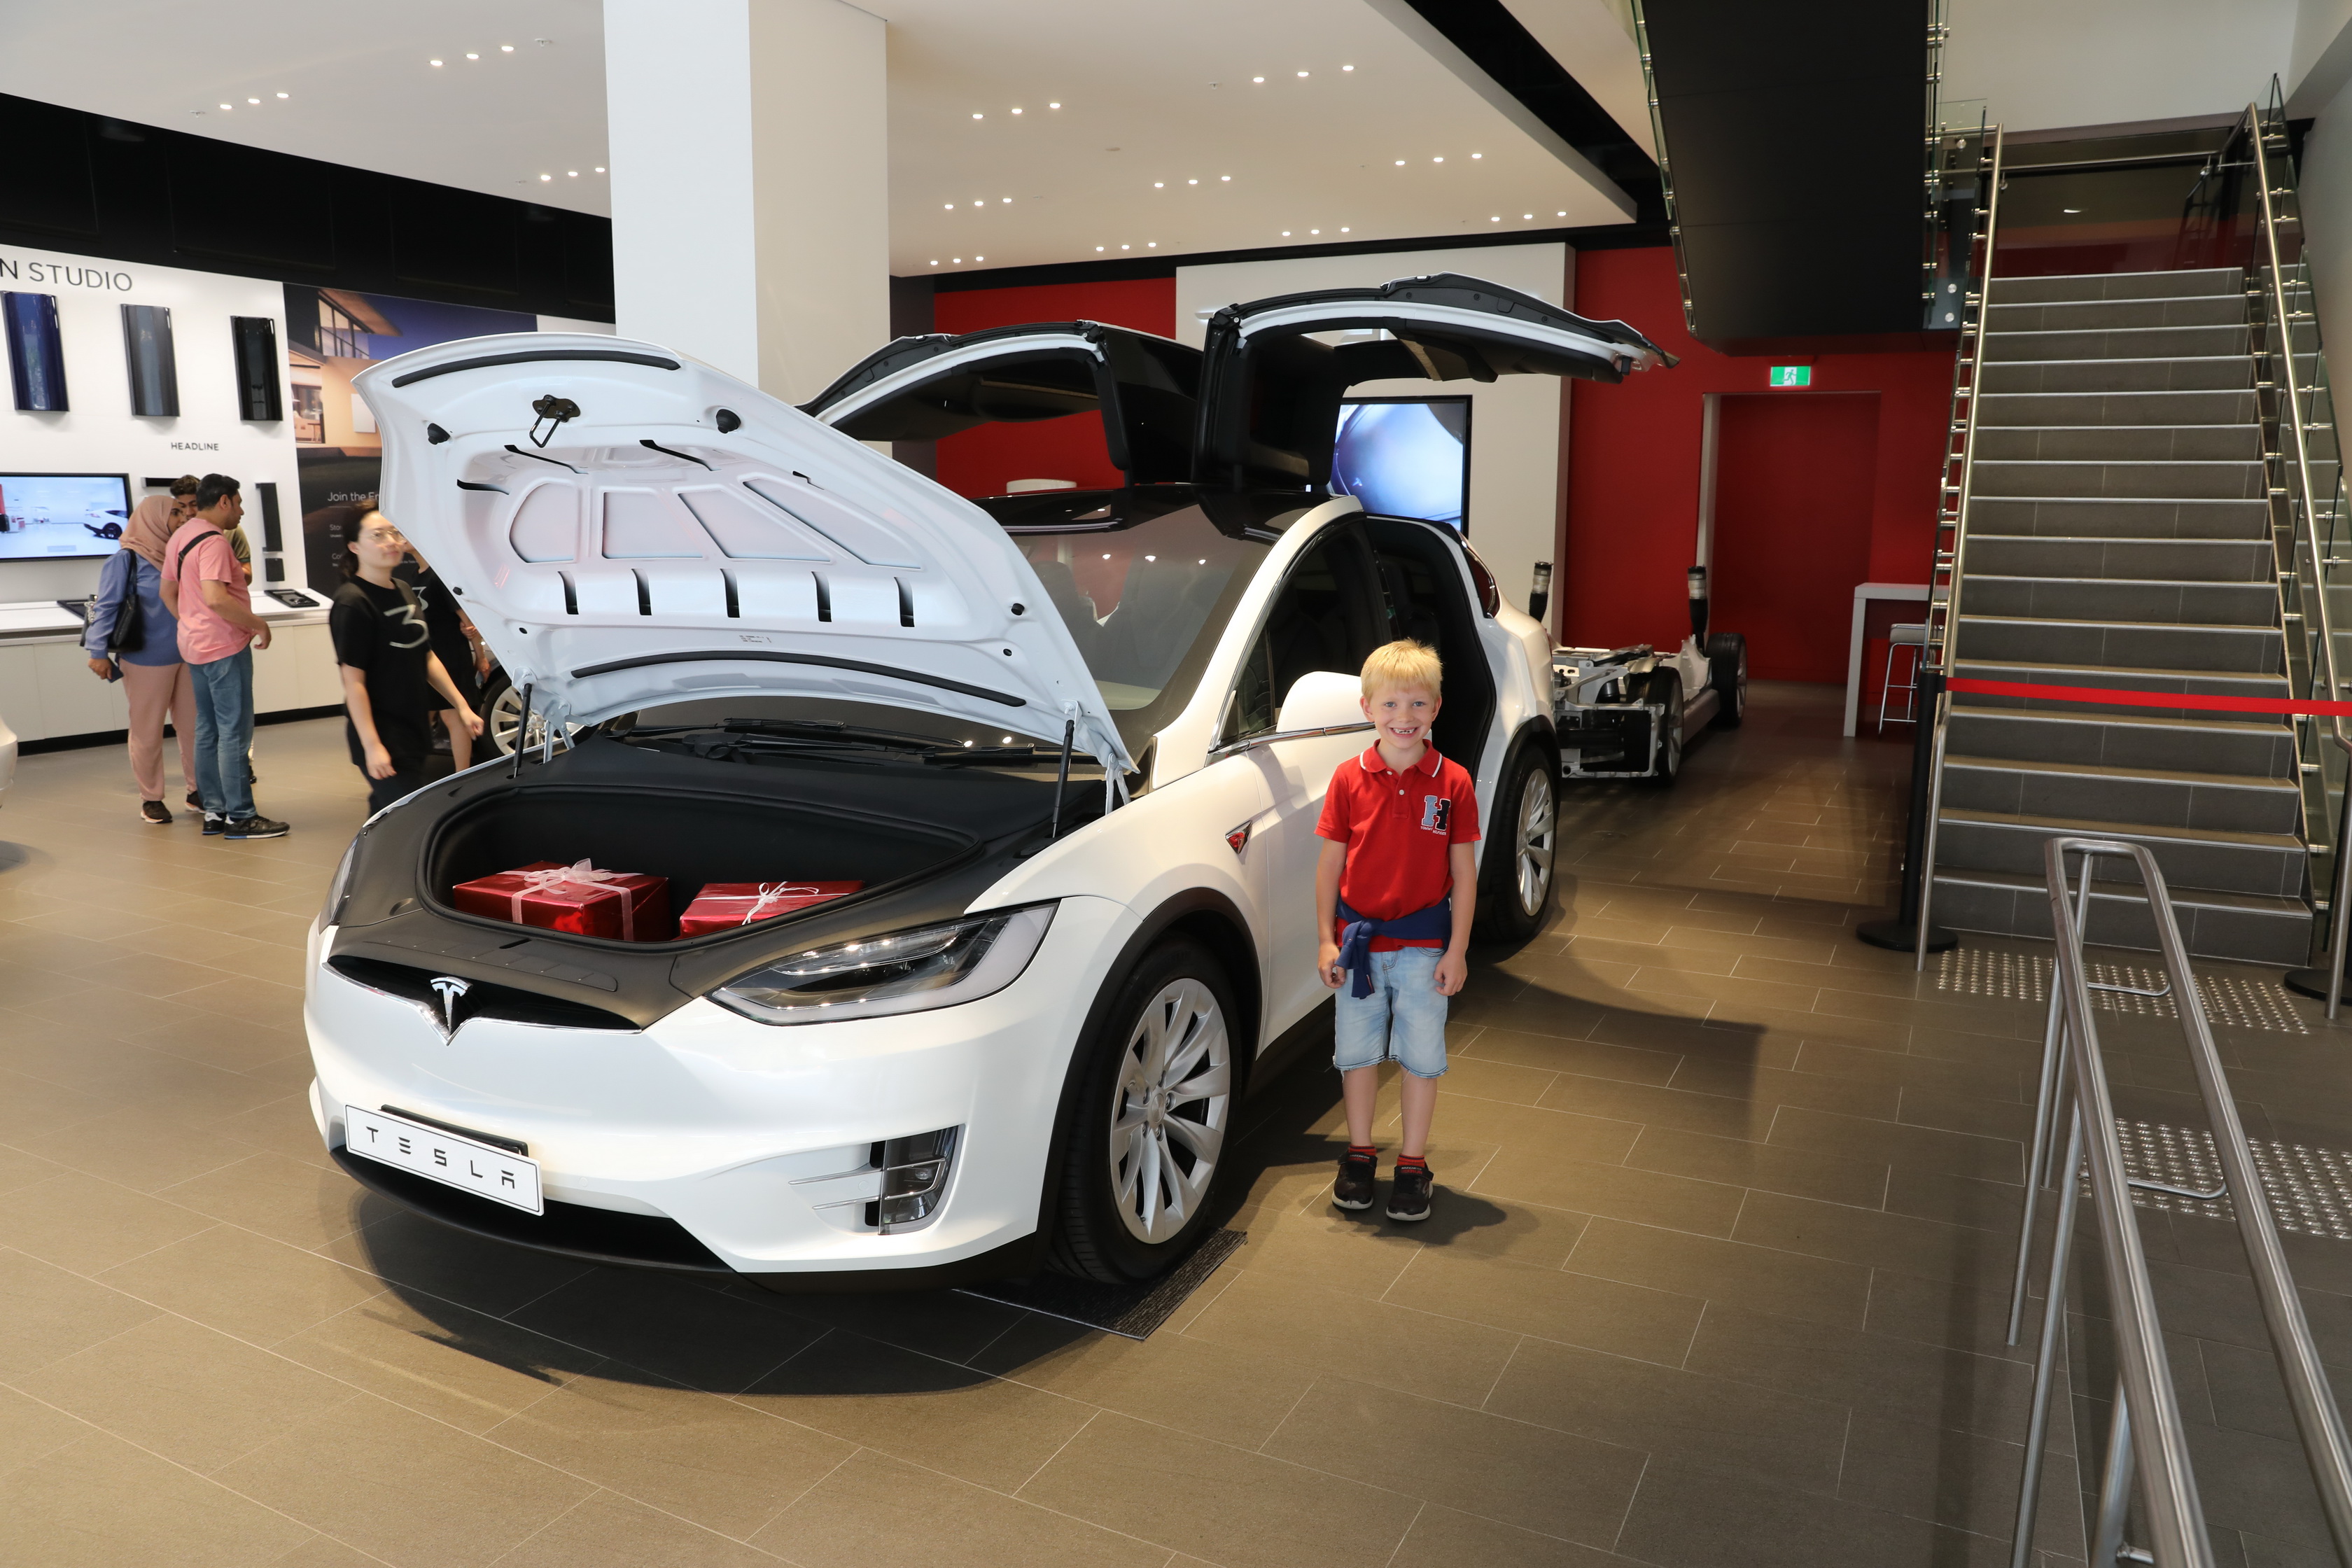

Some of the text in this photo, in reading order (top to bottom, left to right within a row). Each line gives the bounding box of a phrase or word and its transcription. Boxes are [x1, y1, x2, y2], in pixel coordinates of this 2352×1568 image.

[29, 262, 132, 292] STUDIO
[171, 442, 220, 451] HEADLINE
[327, 491, 348, 502] Join
[350, 491, 366, 502] the
[383, 603, 429, 649] 3
[1421, 794, 1451, 832] H
[365, 1125, 516, 1189] TESLA
